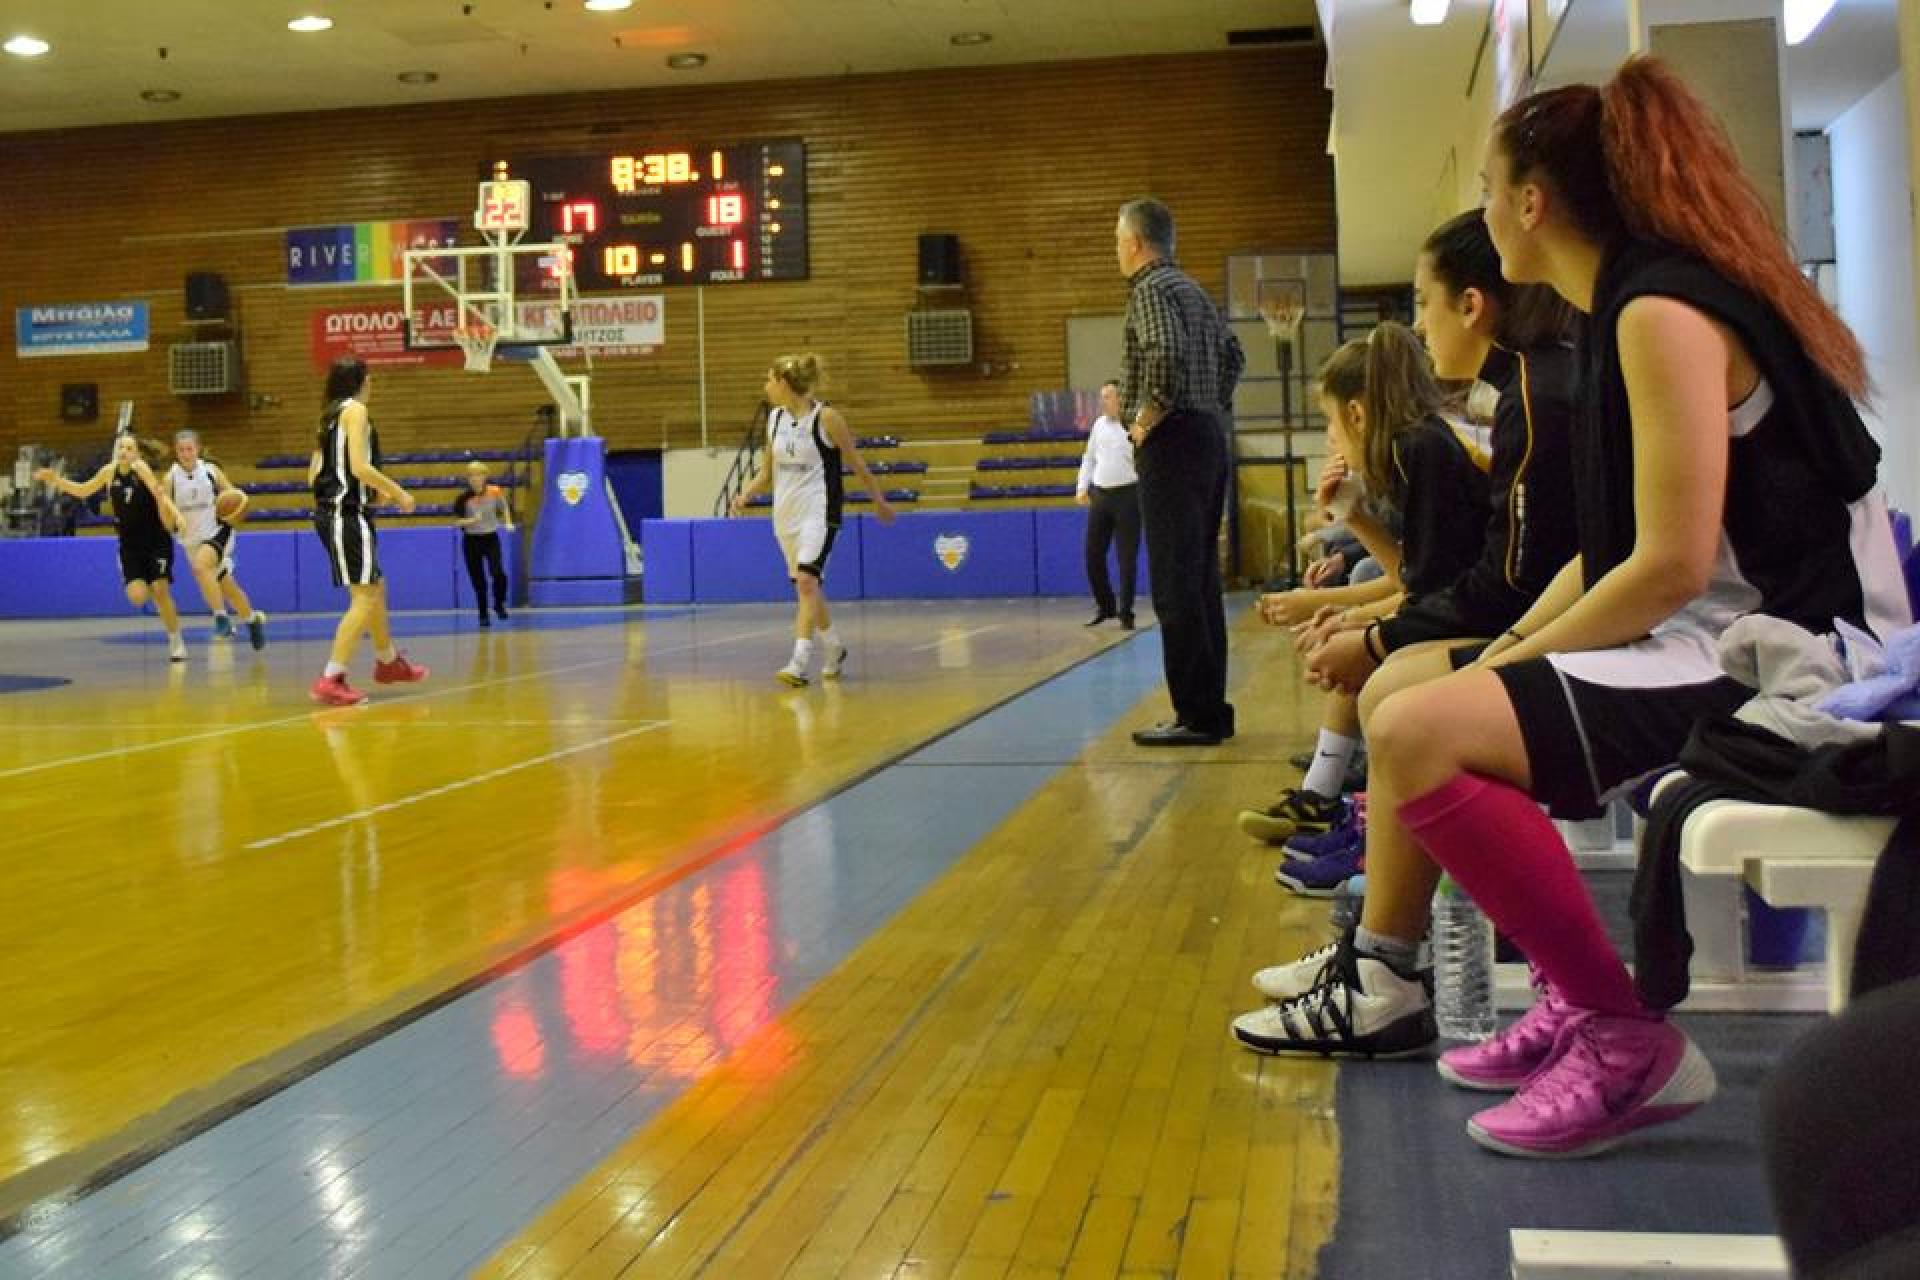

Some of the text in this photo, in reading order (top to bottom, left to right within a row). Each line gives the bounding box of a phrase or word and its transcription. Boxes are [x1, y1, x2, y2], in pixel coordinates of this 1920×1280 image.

[563, 204, 595, 232] 17
[709, 194, 742, 224] 18
[289, 243, 369, 268] RIVER
[605, 247, 637, 275] 10
